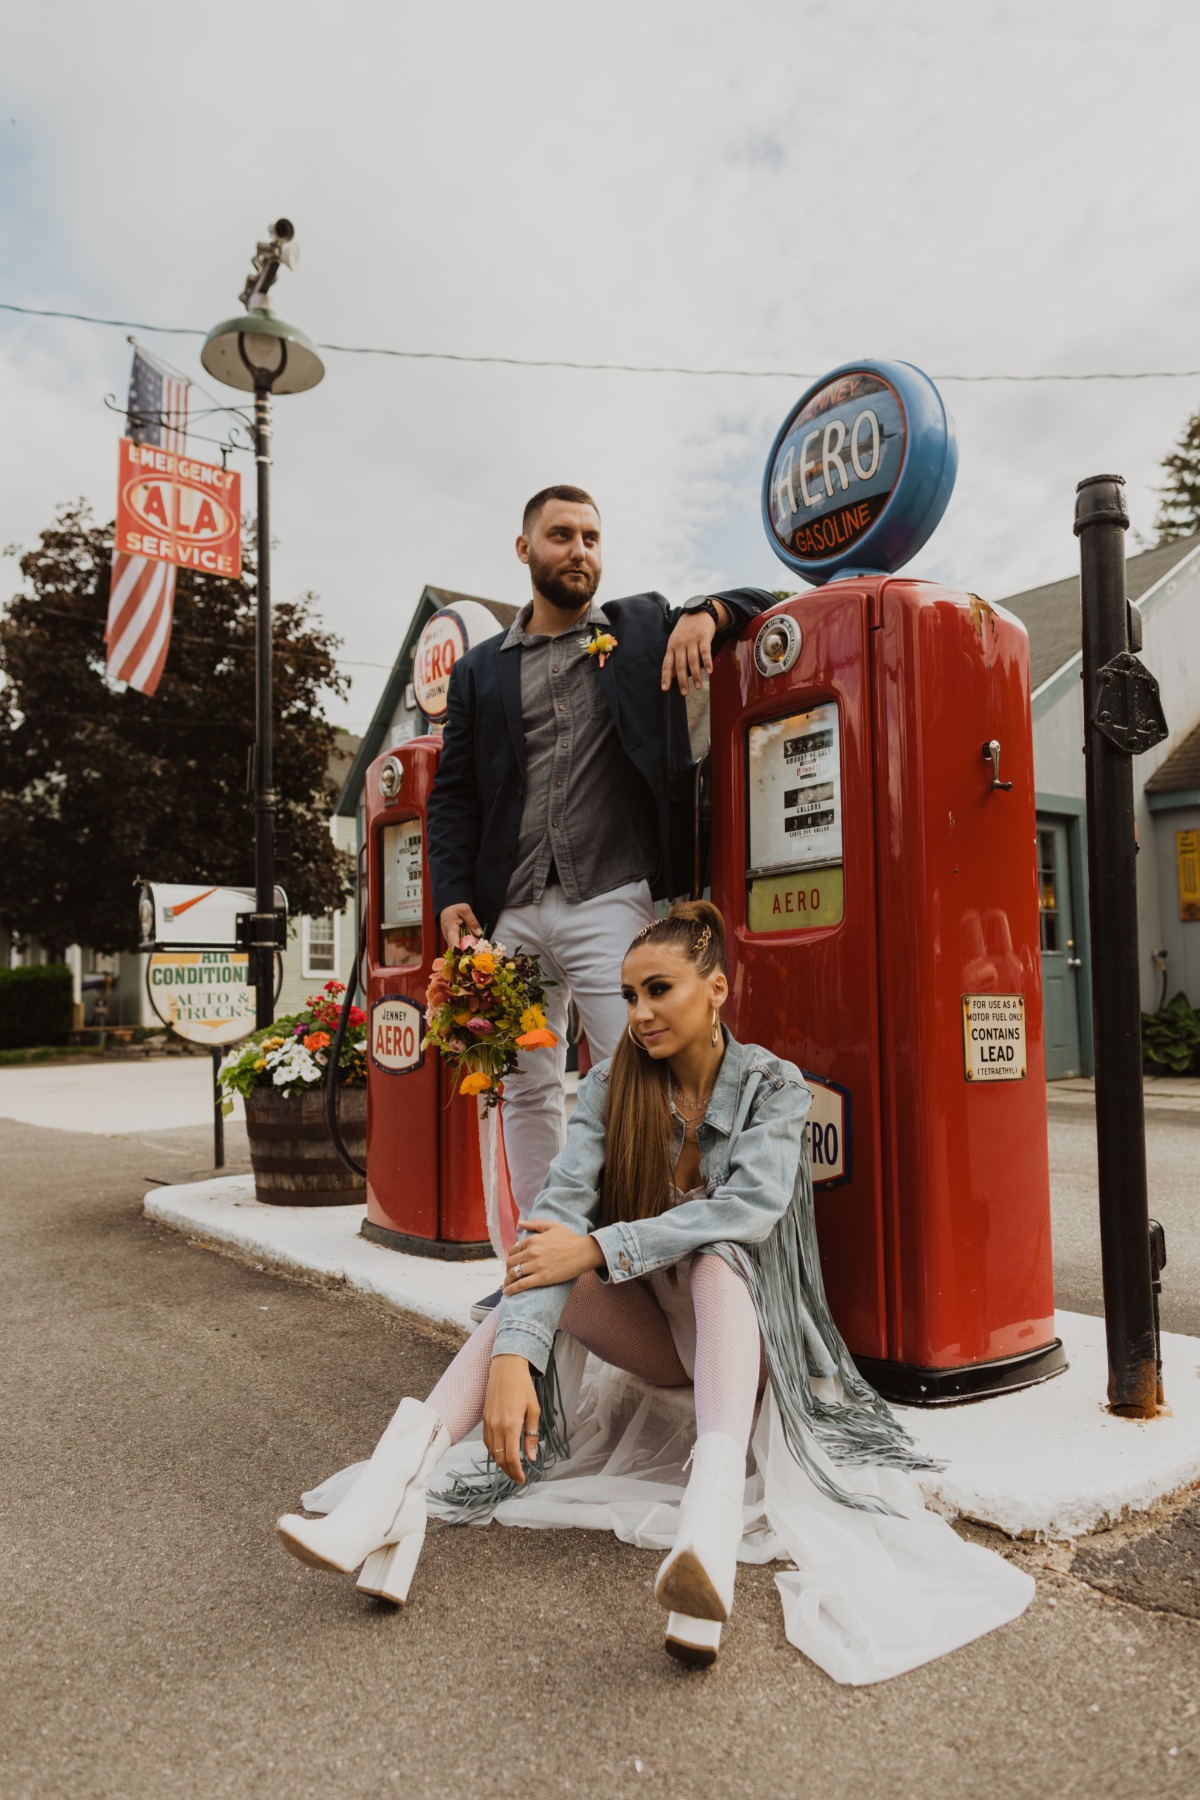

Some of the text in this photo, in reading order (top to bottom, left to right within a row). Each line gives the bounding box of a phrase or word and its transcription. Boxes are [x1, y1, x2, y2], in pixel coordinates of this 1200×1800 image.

[128, 444, 234, 490] EMERGENCY
[776, 409, 881, 520] AERO
[142, 485, 218, 535] ALA
[795, 503, 871, 552] GASOLINE
[126, 531, 233, 573] SERVICE
[418, 638, 455, 687] AERO
[797, 803, 821, 814] GALLONS
[772, 888, 821, 914] AERO
[152, 966, 249, 985] CONDITIONI
[177, 992, 249, 1006] AUTO &
[973, 1000, 1017, 1009] FOR USE AS A
[176, 1004, 256, 1020] TRUCKS
[382, 1008, 407, 1021] JENNEY
[967, 1013, 1023, 1021] MOTOR FUEL ONLY
[375, 1024, 414, 1057] AERO
[971, 1028, 1020, 1041] CONTAINS
[980, 1046, 1014, 1062] LEAD
[806, 1121, 838, 1165] RO
